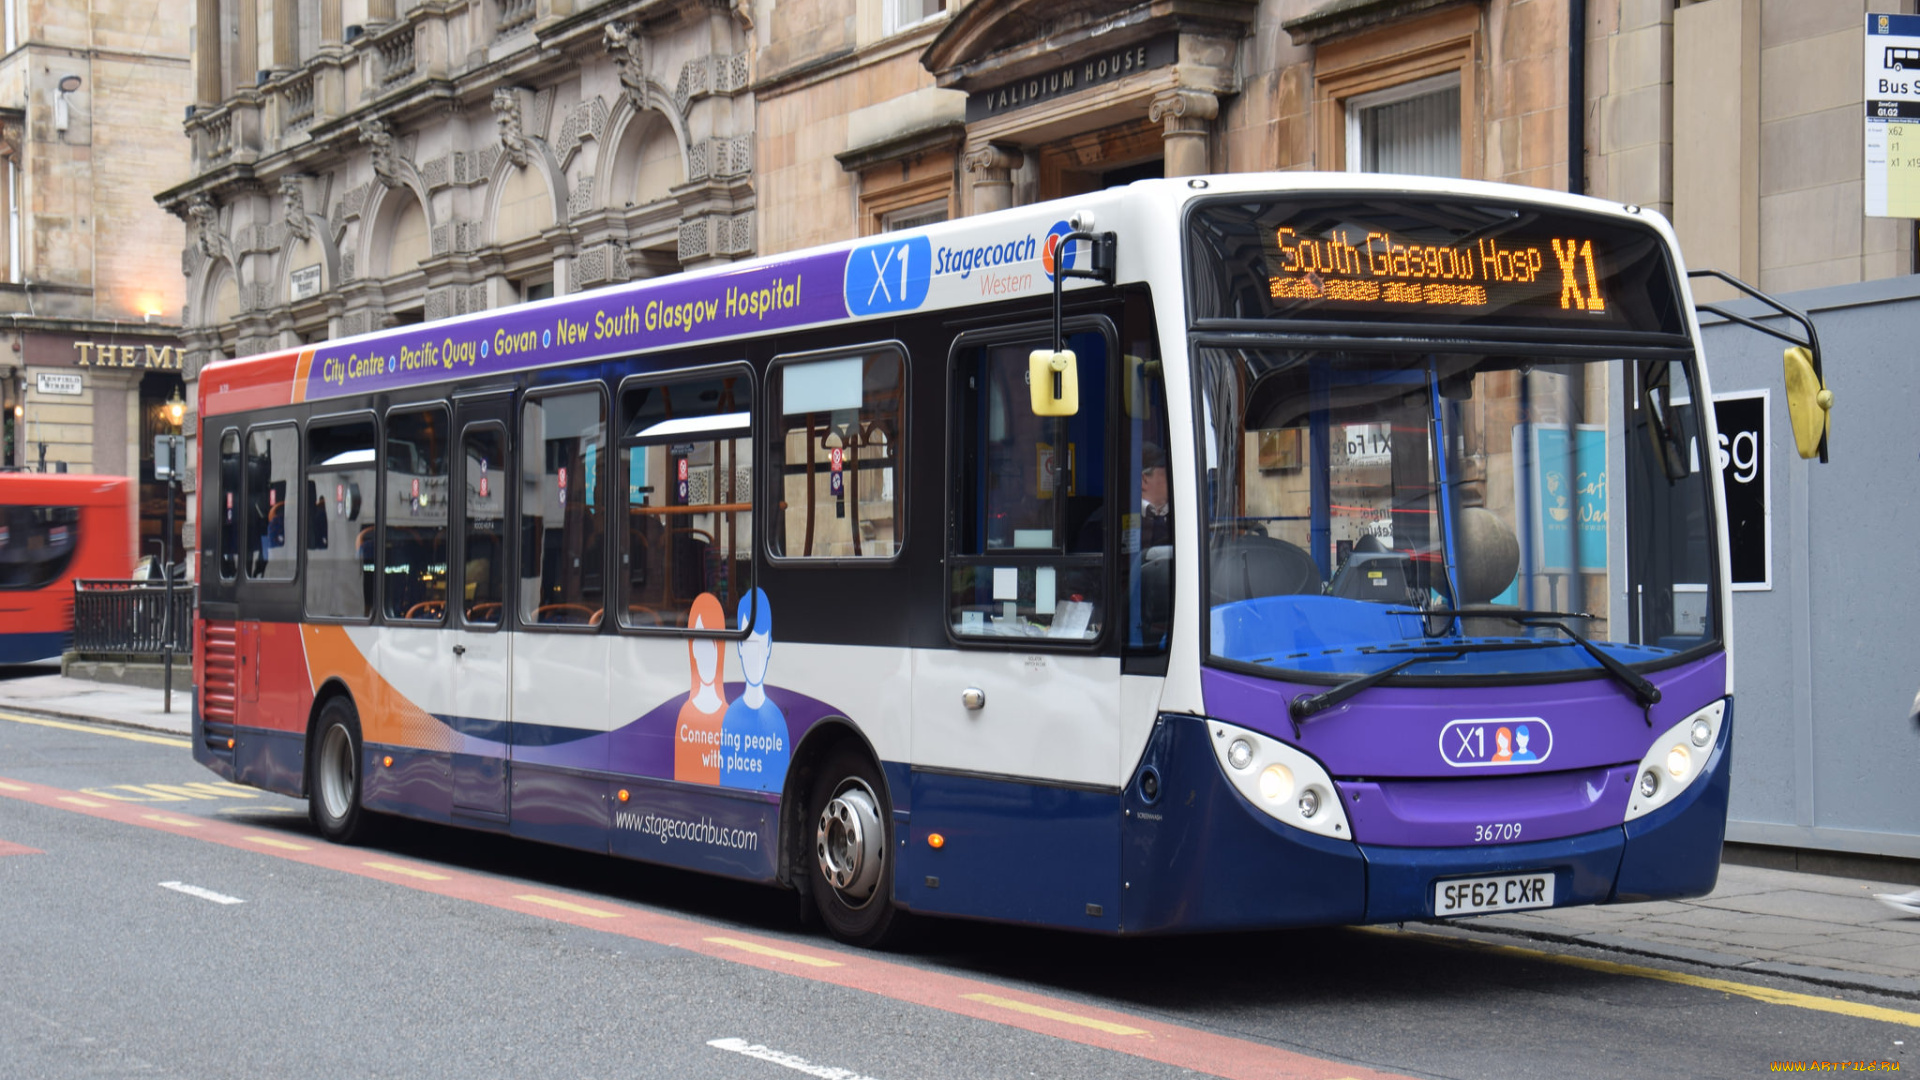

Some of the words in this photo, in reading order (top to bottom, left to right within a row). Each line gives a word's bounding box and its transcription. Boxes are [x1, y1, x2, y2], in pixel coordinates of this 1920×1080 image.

[987, 69, 1074, 111] VALIDIUM
[1085, 47, 1146, 82] HOUSE
[1878, 78, 1908, 94] Bus
[935, 234, 1036, 279] Stagecoach
[1277, 227, 1360, 274] South
[1366, 232, 1474, 279] Glasgow
[1479, 238, 1543, 283] Hosp
[868, 243, 909, 306] X1
[980, 272, 1032, 296] Western
[1551, 238, 1605, 310] X1
[323, 356, 345, 385] City
[347, 353, 385, 374] Centre
[399, 345, 439, 371] Pacific
[441, 338, 476, 369] Quay
[494, 328, 537, 356] Govan
[556, 318, 589, 347] New
[594, 304, 639, 340] South
[644, 298, 719, 333] Glasgow
[725, 274, 802, 321] Hospital
[74, 341, 136, 367] THE
[680, 724, 741, 752] Connecting
[744, 732, 783, 755] people
[1456, 726, 1484, 759] X1
[702, 750, 724, 769] with
[727, 752, 763, 774] places
[615, 811, 758, 851] www.stagecoachbus.com
[1474, 822, 1522, 842] 36709
[1444, 881, 1499, 910] SF62
[1504, 878, 1546, 905] CXR
